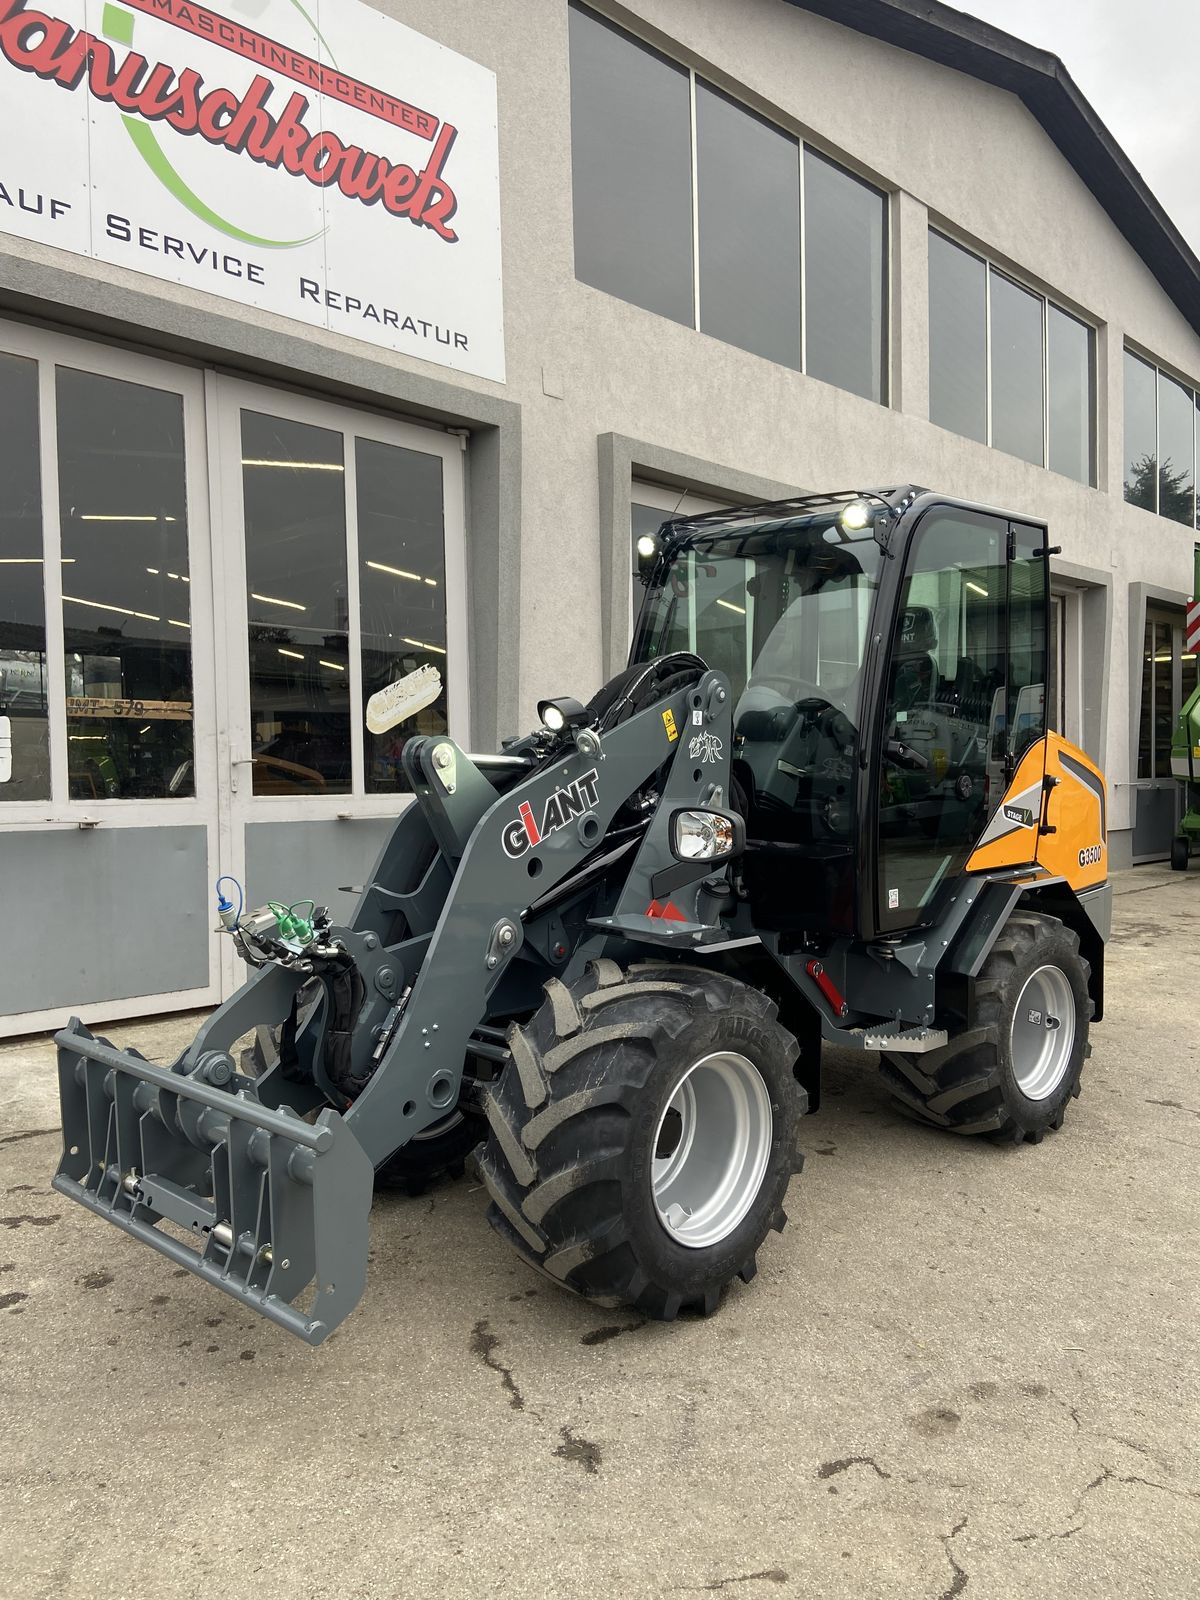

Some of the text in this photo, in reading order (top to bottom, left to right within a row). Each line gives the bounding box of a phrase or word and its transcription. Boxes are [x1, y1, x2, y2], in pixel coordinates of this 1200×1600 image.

[141, 0, 430, 133] MASCHINEN-CENTER
[114, 701, 144, 716] 579
[1006, 810, 1023, 822] STAGE
[1078, 844, 1102, 868] G3500
